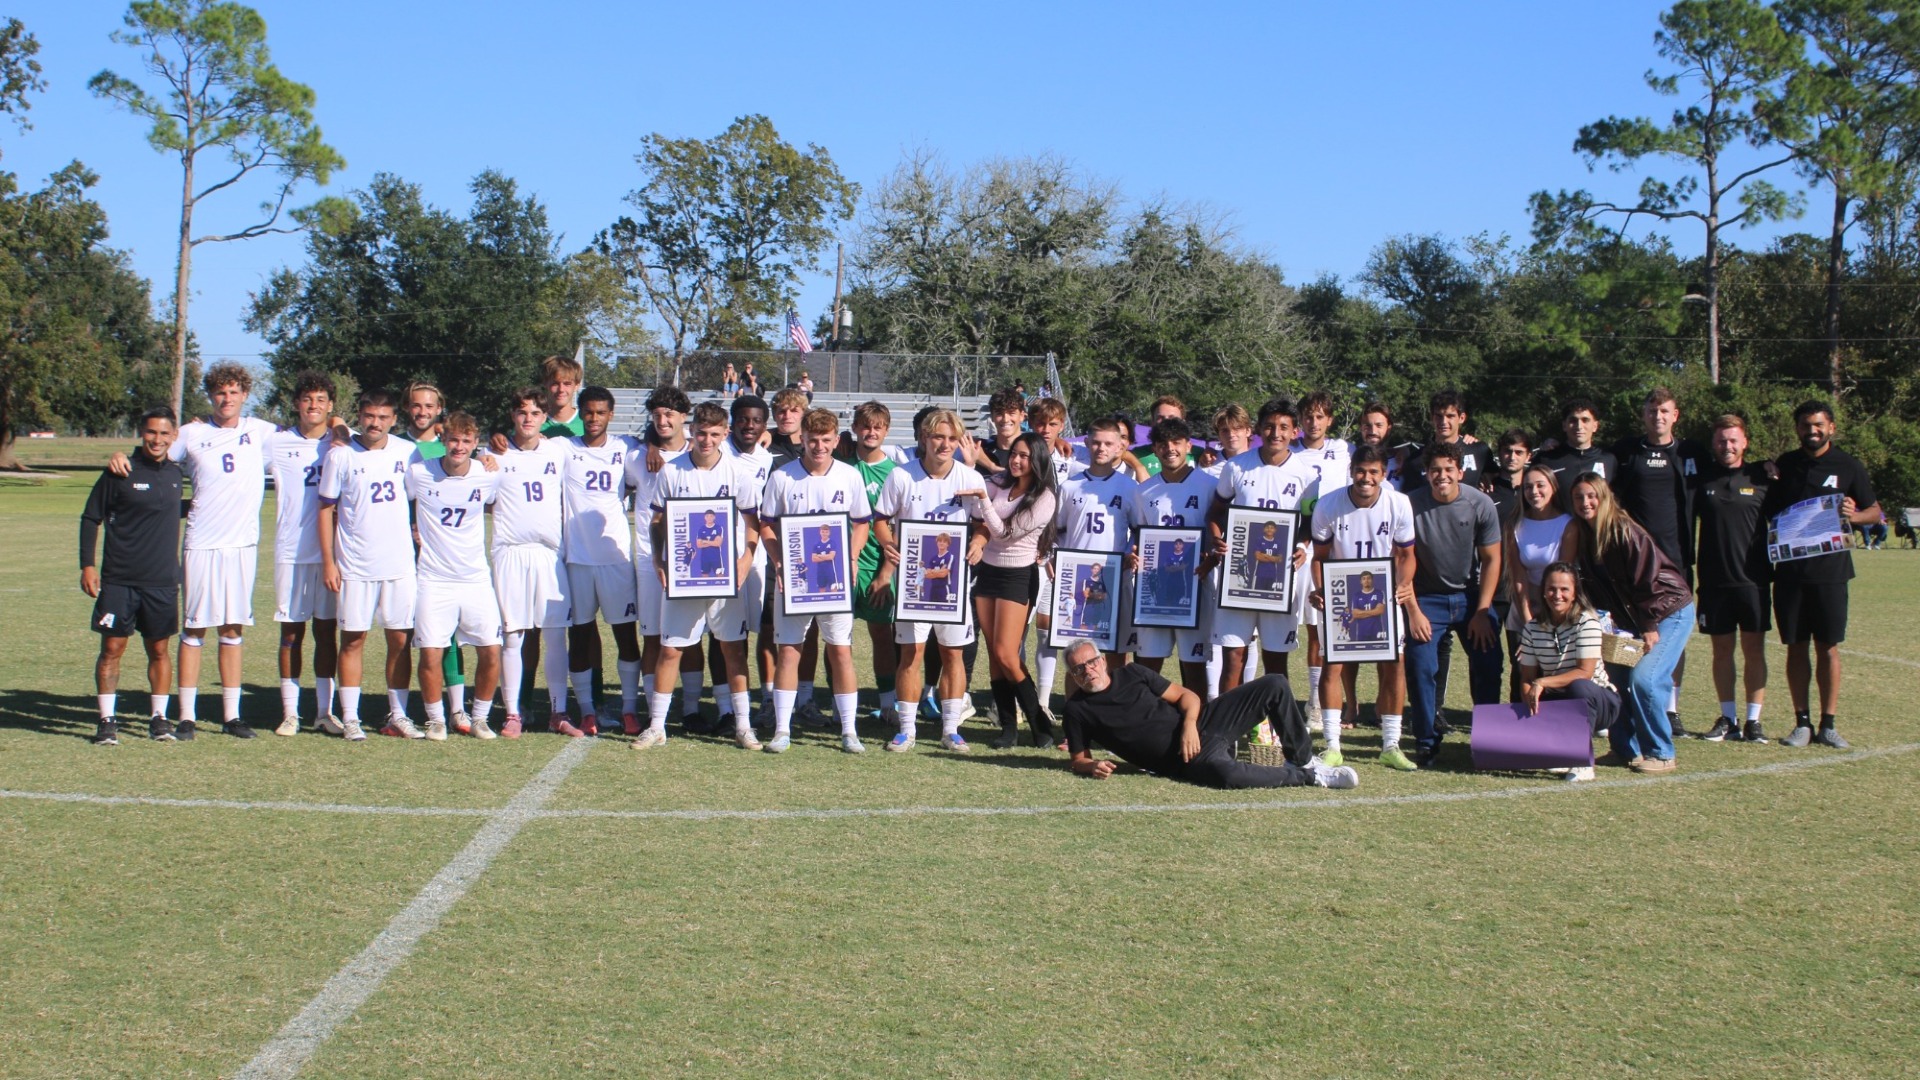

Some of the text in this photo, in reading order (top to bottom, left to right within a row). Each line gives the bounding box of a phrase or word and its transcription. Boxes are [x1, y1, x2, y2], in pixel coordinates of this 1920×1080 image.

[222, 453, 235, 473] 6
[585, 470, 612, 491] 20
[371, 480, 396, 503] 23
[522, 481, 544, 502] 19
[441, 507, 467, 528] 27
[1086, 512, 1105, 534] 15
